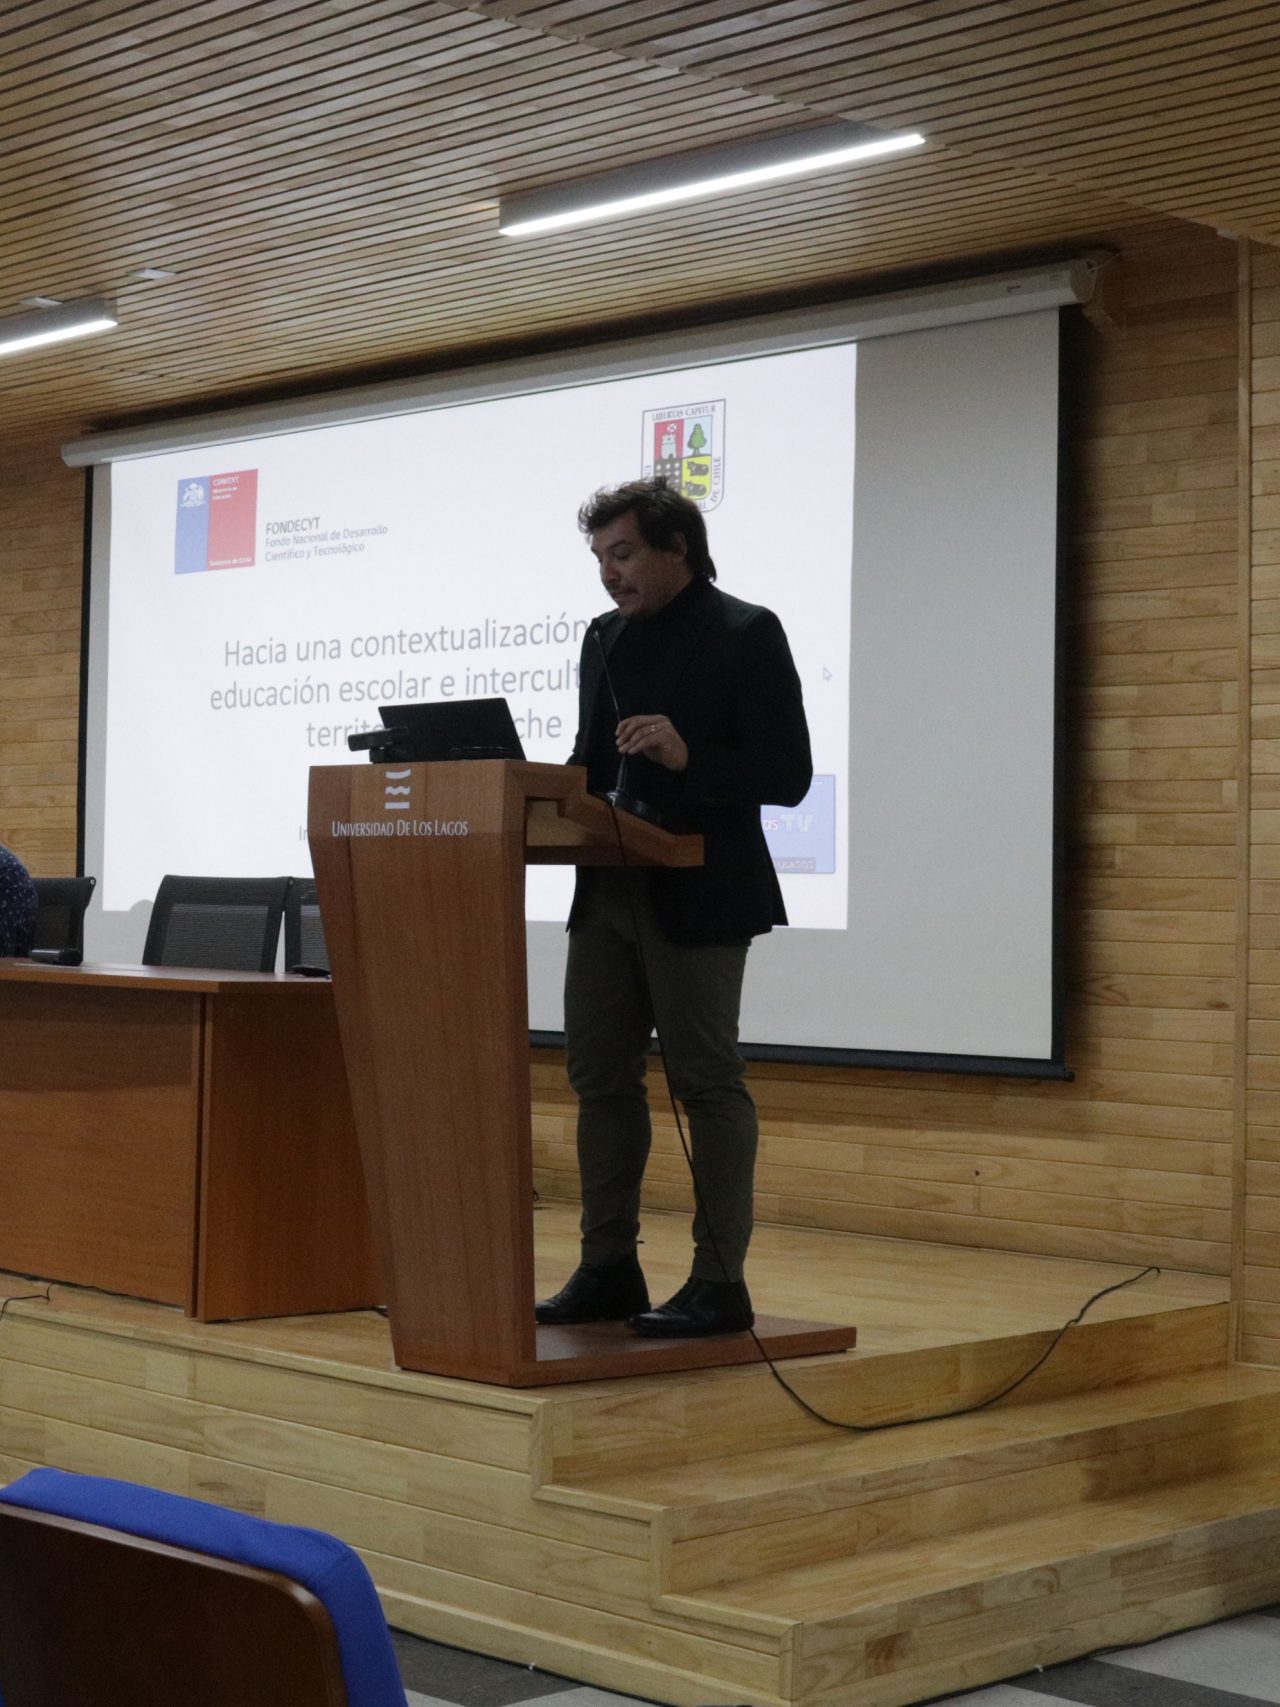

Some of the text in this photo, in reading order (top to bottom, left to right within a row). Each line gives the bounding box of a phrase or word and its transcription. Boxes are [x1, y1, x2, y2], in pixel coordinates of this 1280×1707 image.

[265, 516, 320, 535] FONDECYT
[265, 524, 388, 548] Fondo Nacional de Desarrollo
[265, 542, 365, 562] Científico y Tecnológico
[224, 611, 589, 667] Hacia una contextualización
[210, 675, 330, 711] educación
[339, 669, 431, 703] escolar
[439, 673, 456, 698] e
[306, 718, 385, 748] territ
[331, 820, 395, 838] UNIVERSIDAD
[413, 819, 433, 837] LOS
[434, 819, 468, 836] LAGOS
